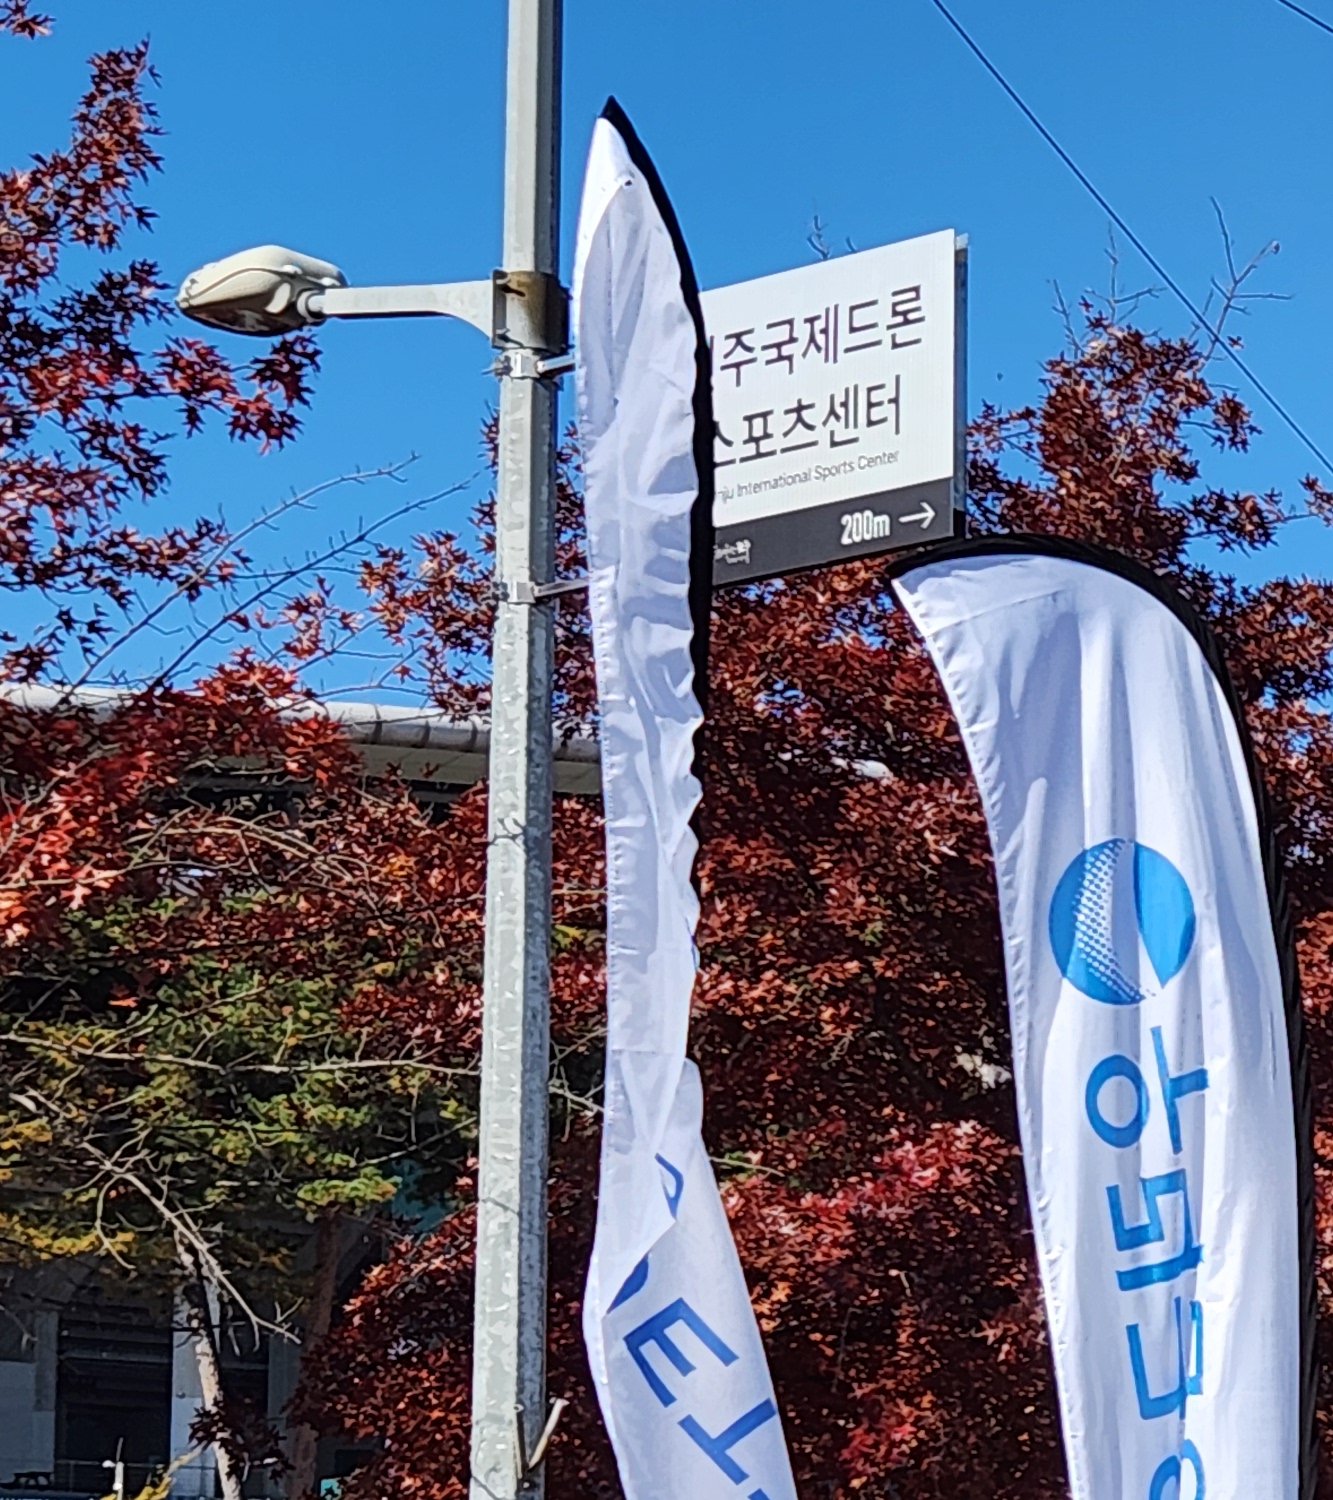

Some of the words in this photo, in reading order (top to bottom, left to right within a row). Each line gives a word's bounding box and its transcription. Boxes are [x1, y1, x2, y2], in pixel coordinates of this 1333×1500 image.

[710, 285, 925, 387] 주국제드론
[714, 374, 901, 468] 스포츠센터
[737, 468, 812, 497] International
[814, 459, 855, 481] Sports
[858, 450, 900, 471] Center
[840, 509, 891, 545] 200m
